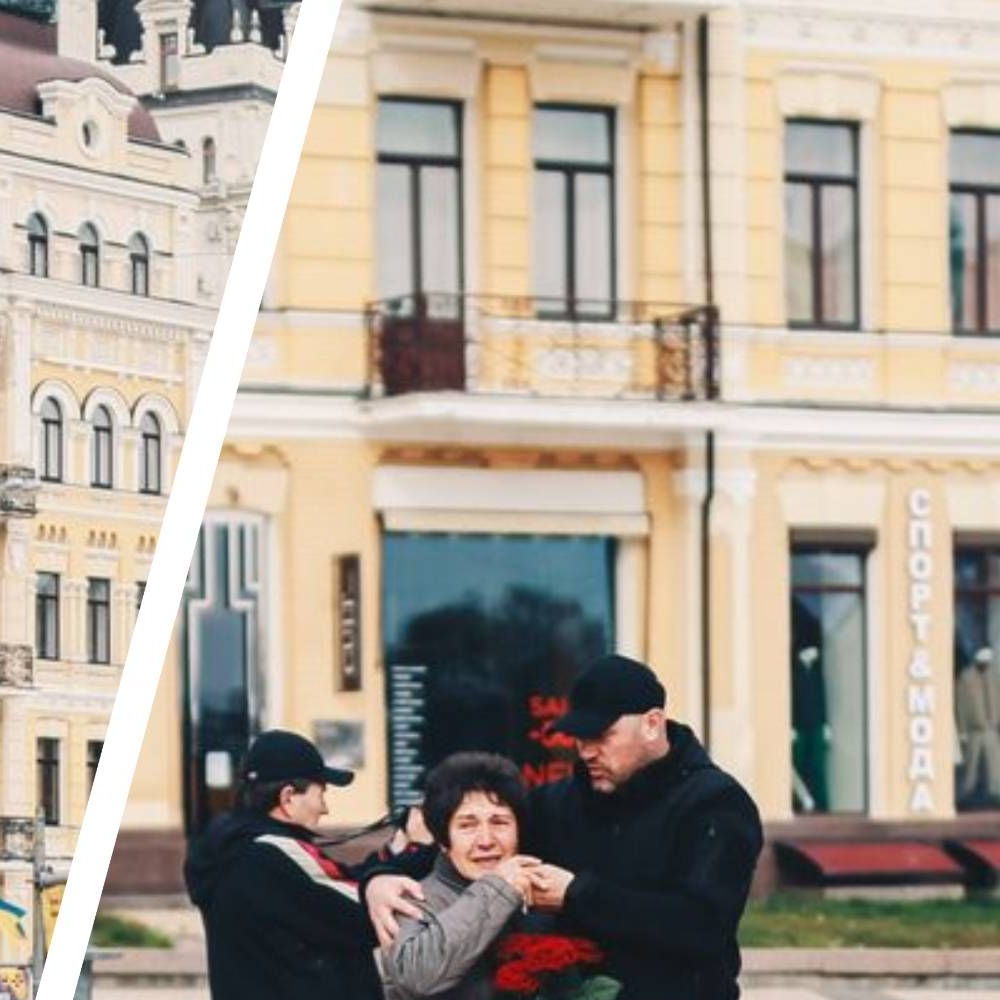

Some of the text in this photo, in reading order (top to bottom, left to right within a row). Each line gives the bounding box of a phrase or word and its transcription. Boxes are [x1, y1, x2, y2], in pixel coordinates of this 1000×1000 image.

[907, 487, 936, 812] СПОРТ & МОДА
